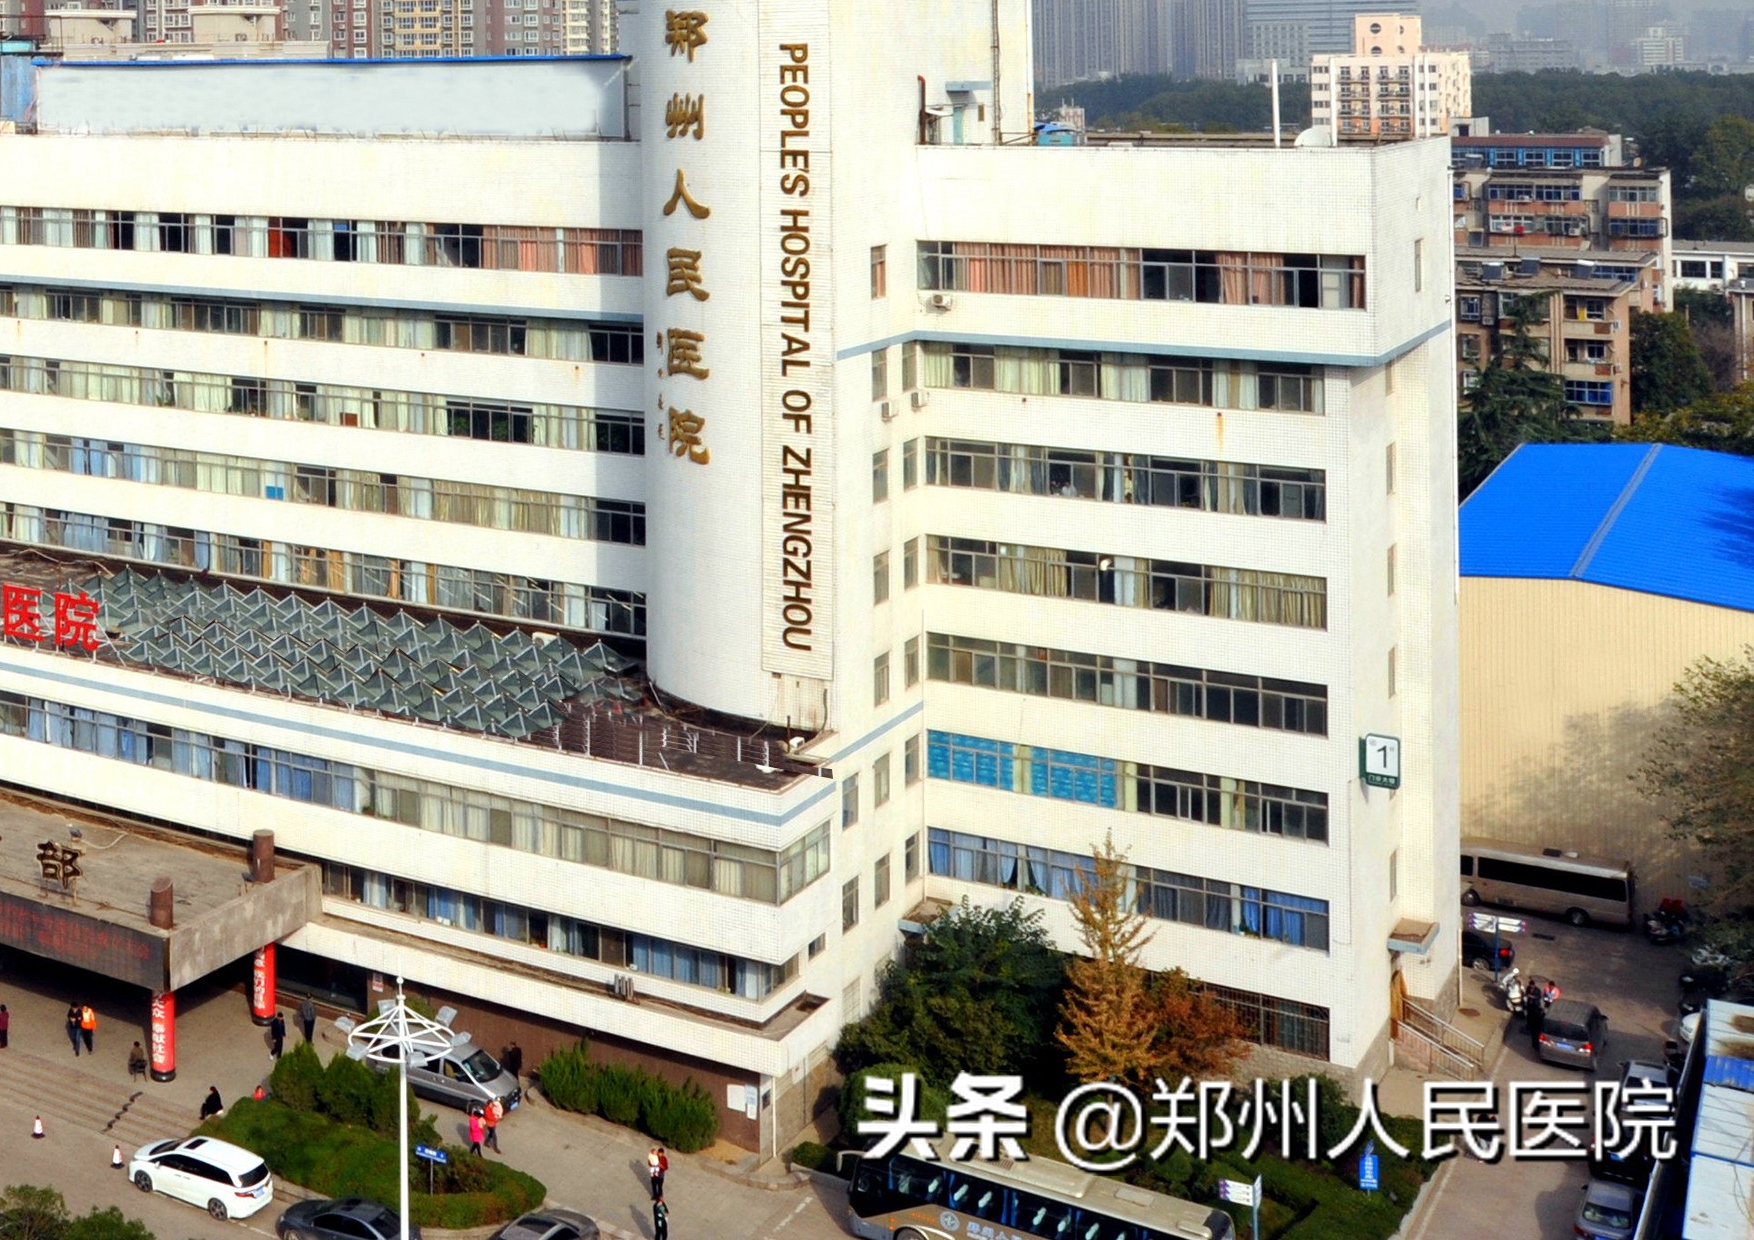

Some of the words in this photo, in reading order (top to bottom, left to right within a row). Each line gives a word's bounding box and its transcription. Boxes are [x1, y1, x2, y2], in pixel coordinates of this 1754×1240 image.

[780, 42, 810, 198] PEOPLE'S
[663, 8, 712, 465] 郑州人民医院
[780, 208, 811, 377] HOSPITAL
[782, 389, 812, 436] OF
[782, 444, 813, 652] ZHENGZHOU
[1377, 745, 1387, 769] 1
